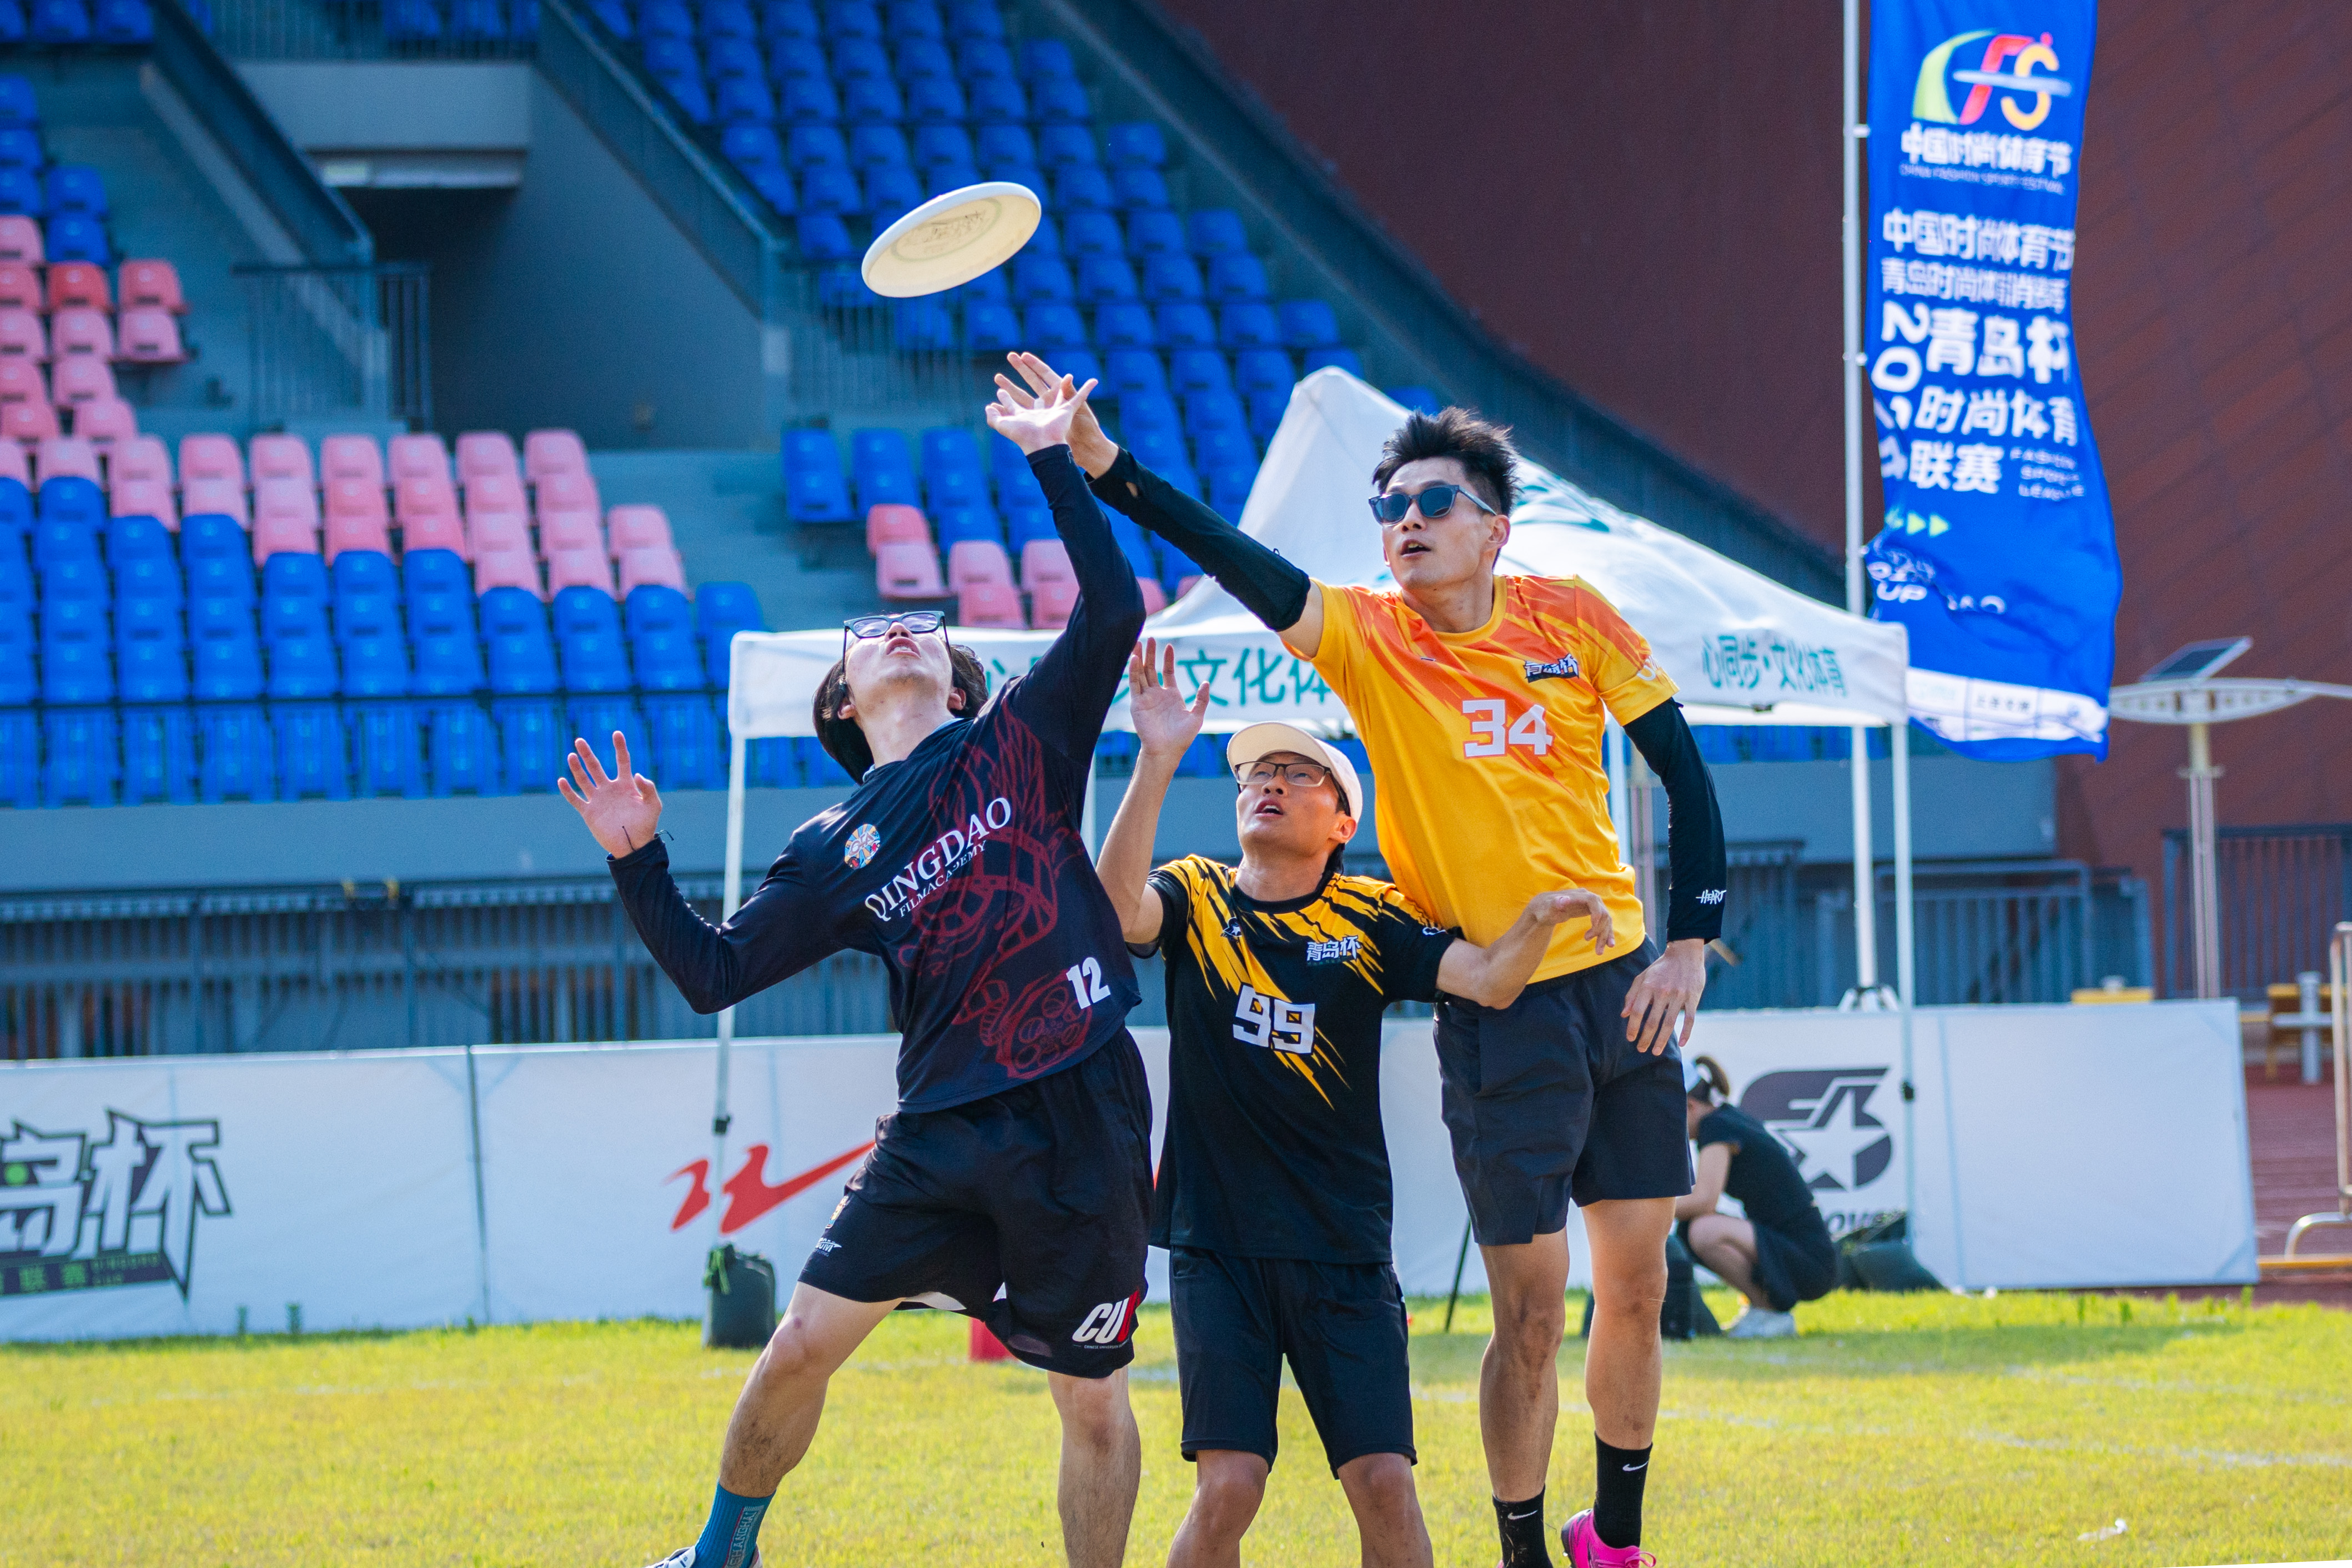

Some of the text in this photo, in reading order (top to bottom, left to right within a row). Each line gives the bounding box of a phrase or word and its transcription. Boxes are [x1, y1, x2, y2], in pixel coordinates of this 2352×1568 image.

[1901, 122, 2073, 179] 中国时尚体育节
[1882, 207, 2076, 272] 中国时尚体育节
[1926, 308, 2070, 384] 青岛杯
[1914, 385, 2078, 446] 时尚体育
[1908, 440, 2004, 494] 联赛
[1462, 698, 1554, 757] 34
[865, 797, 1011, 922] QINGDAO
[1696, 889, 1727, 904] HEART
[1306, 936, 1361, 961] 青岛杯
[1066, 957, 1110, 1009] 12
[1232, 984, 1315, 1054] 99
